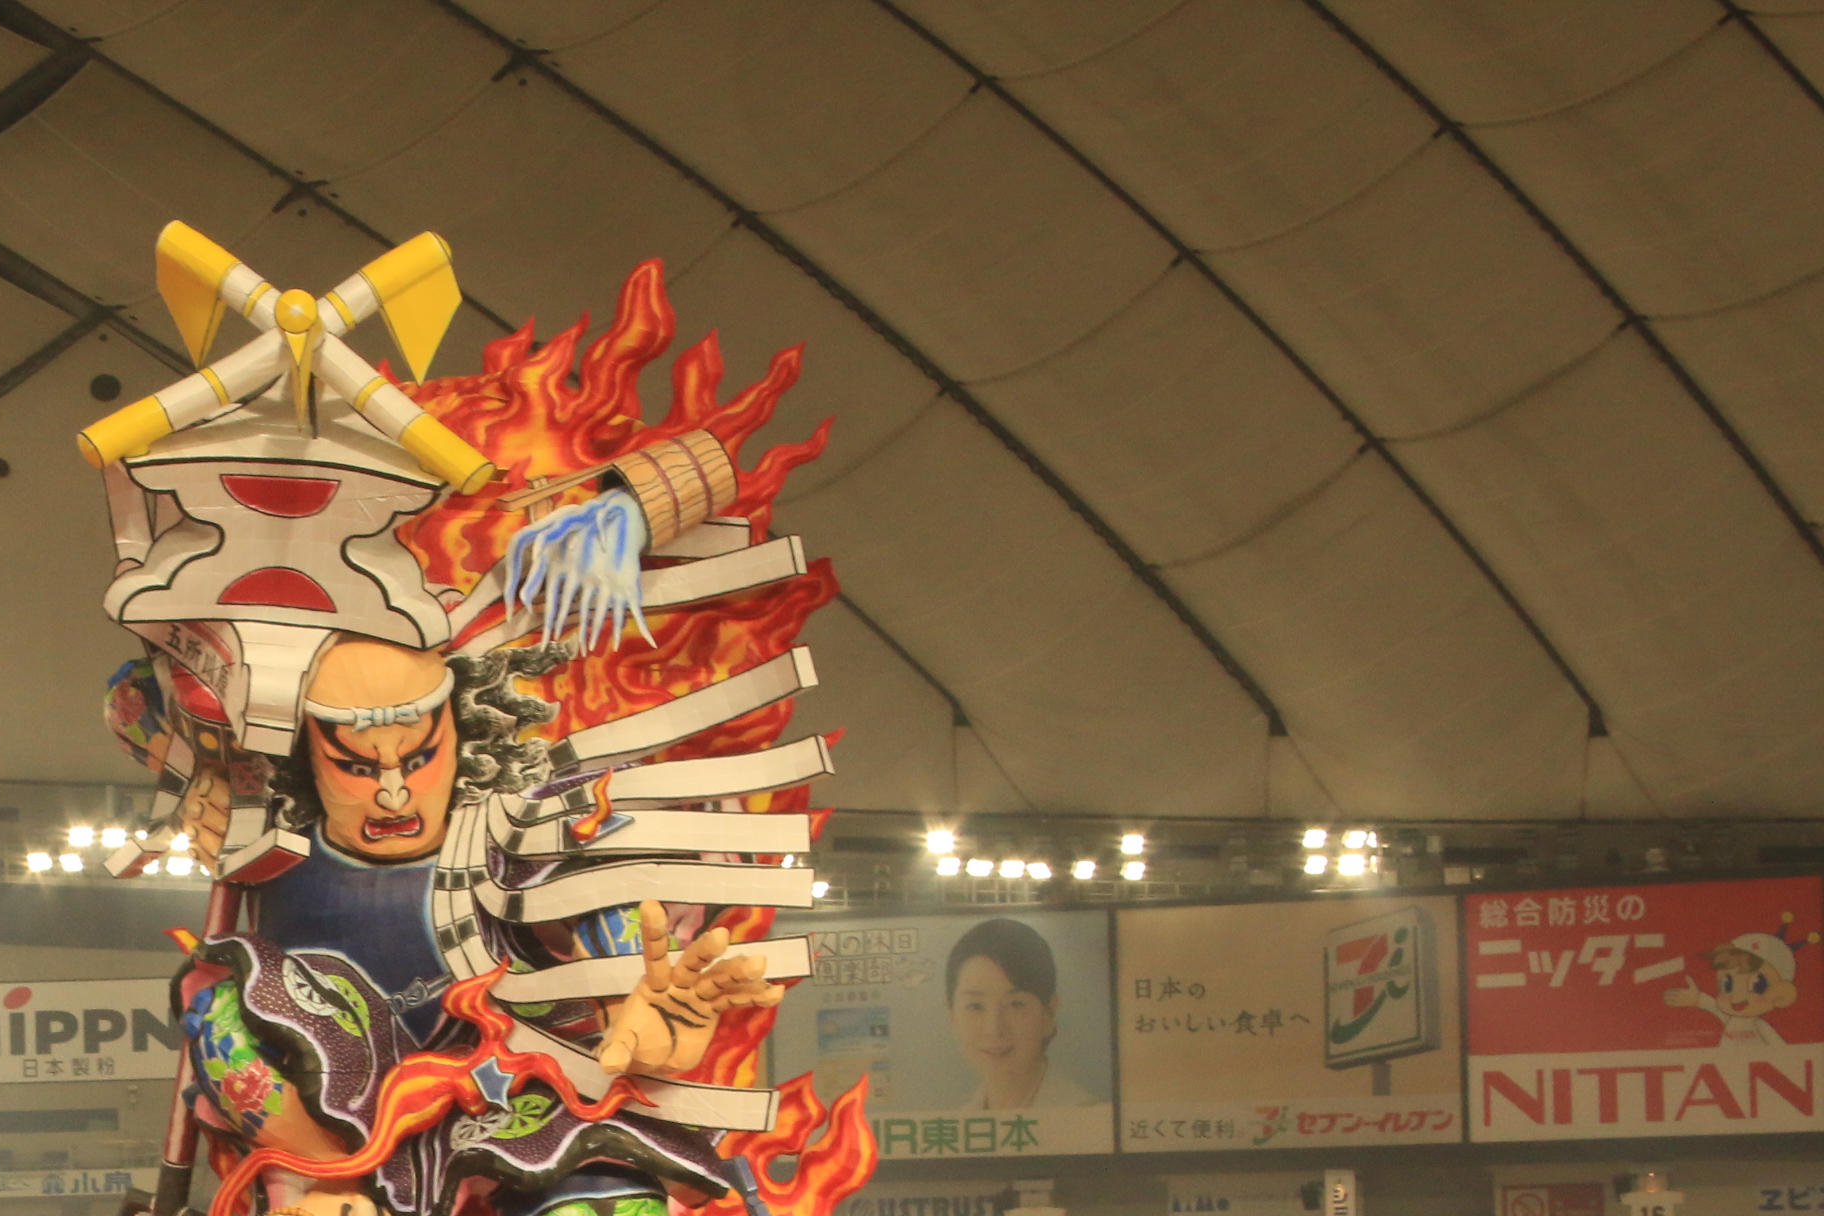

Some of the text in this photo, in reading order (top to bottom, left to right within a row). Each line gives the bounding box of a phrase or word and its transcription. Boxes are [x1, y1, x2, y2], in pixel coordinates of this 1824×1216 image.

[1479, 895, 1646, 928] 総合防災の
[1477, 933, 1685, 988] ニッタン
[1133, 978, 1207, 1000] 日本の
[1134, 1011, 1312, 1036] おいしい食卓へ
[22, 1059, 116, 1078] 日本製粉
[1483, 1060, 1814, 1126] NITTAN
